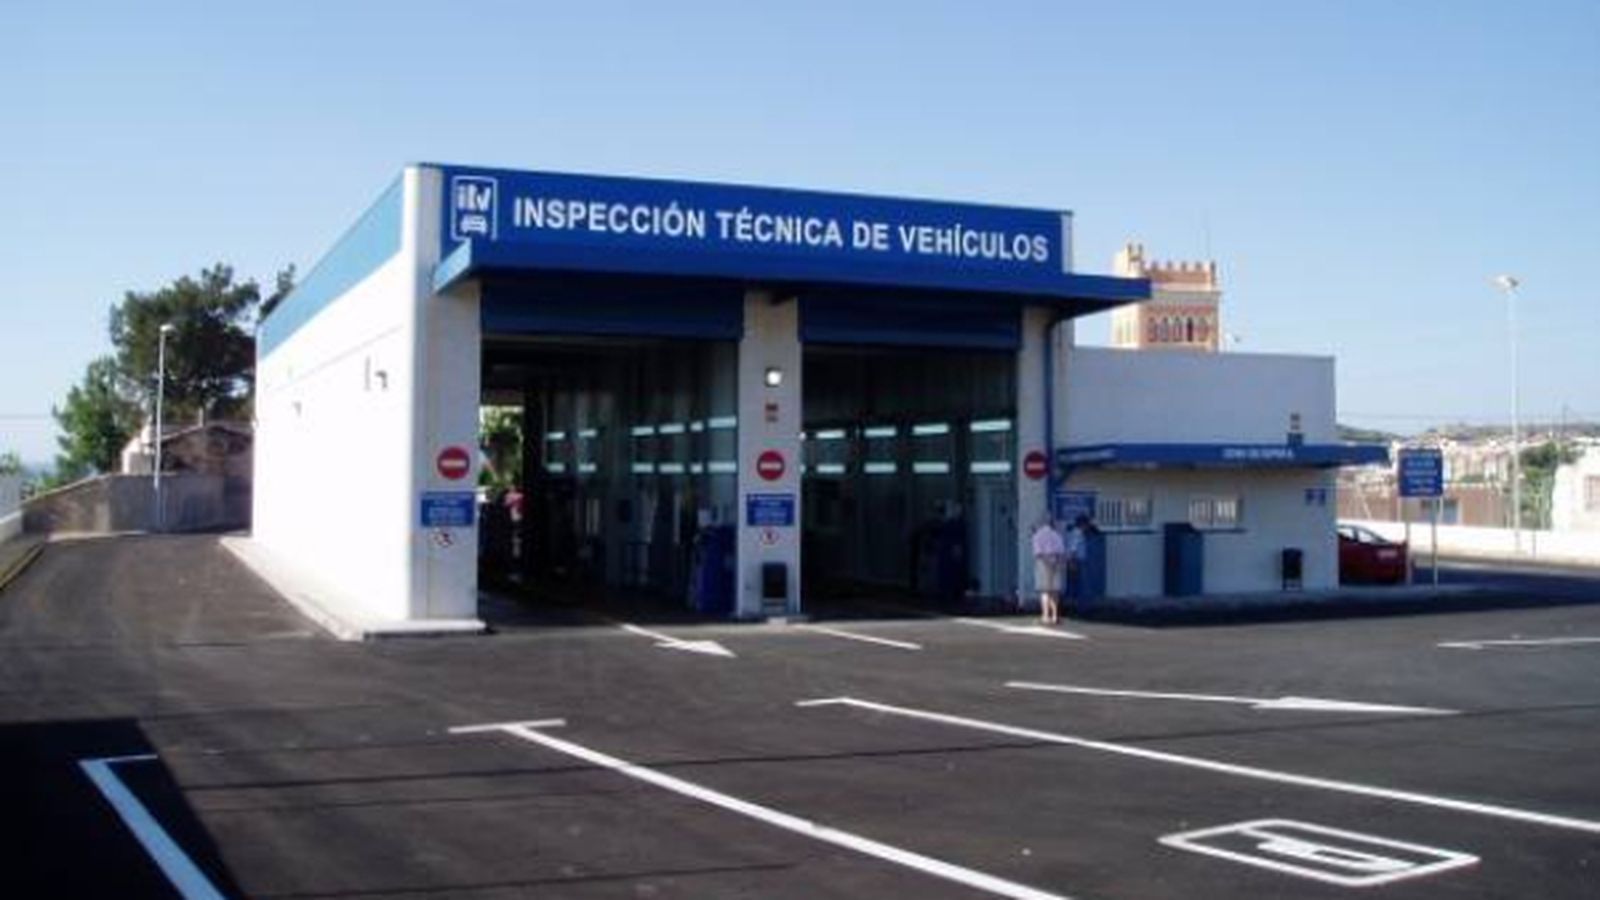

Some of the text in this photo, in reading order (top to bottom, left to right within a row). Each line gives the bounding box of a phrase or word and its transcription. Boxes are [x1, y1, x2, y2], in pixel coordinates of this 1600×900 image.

[513, 197, 1049, 263] INSPECCIÓN TÉCNICA DE VEHÍCULOS
